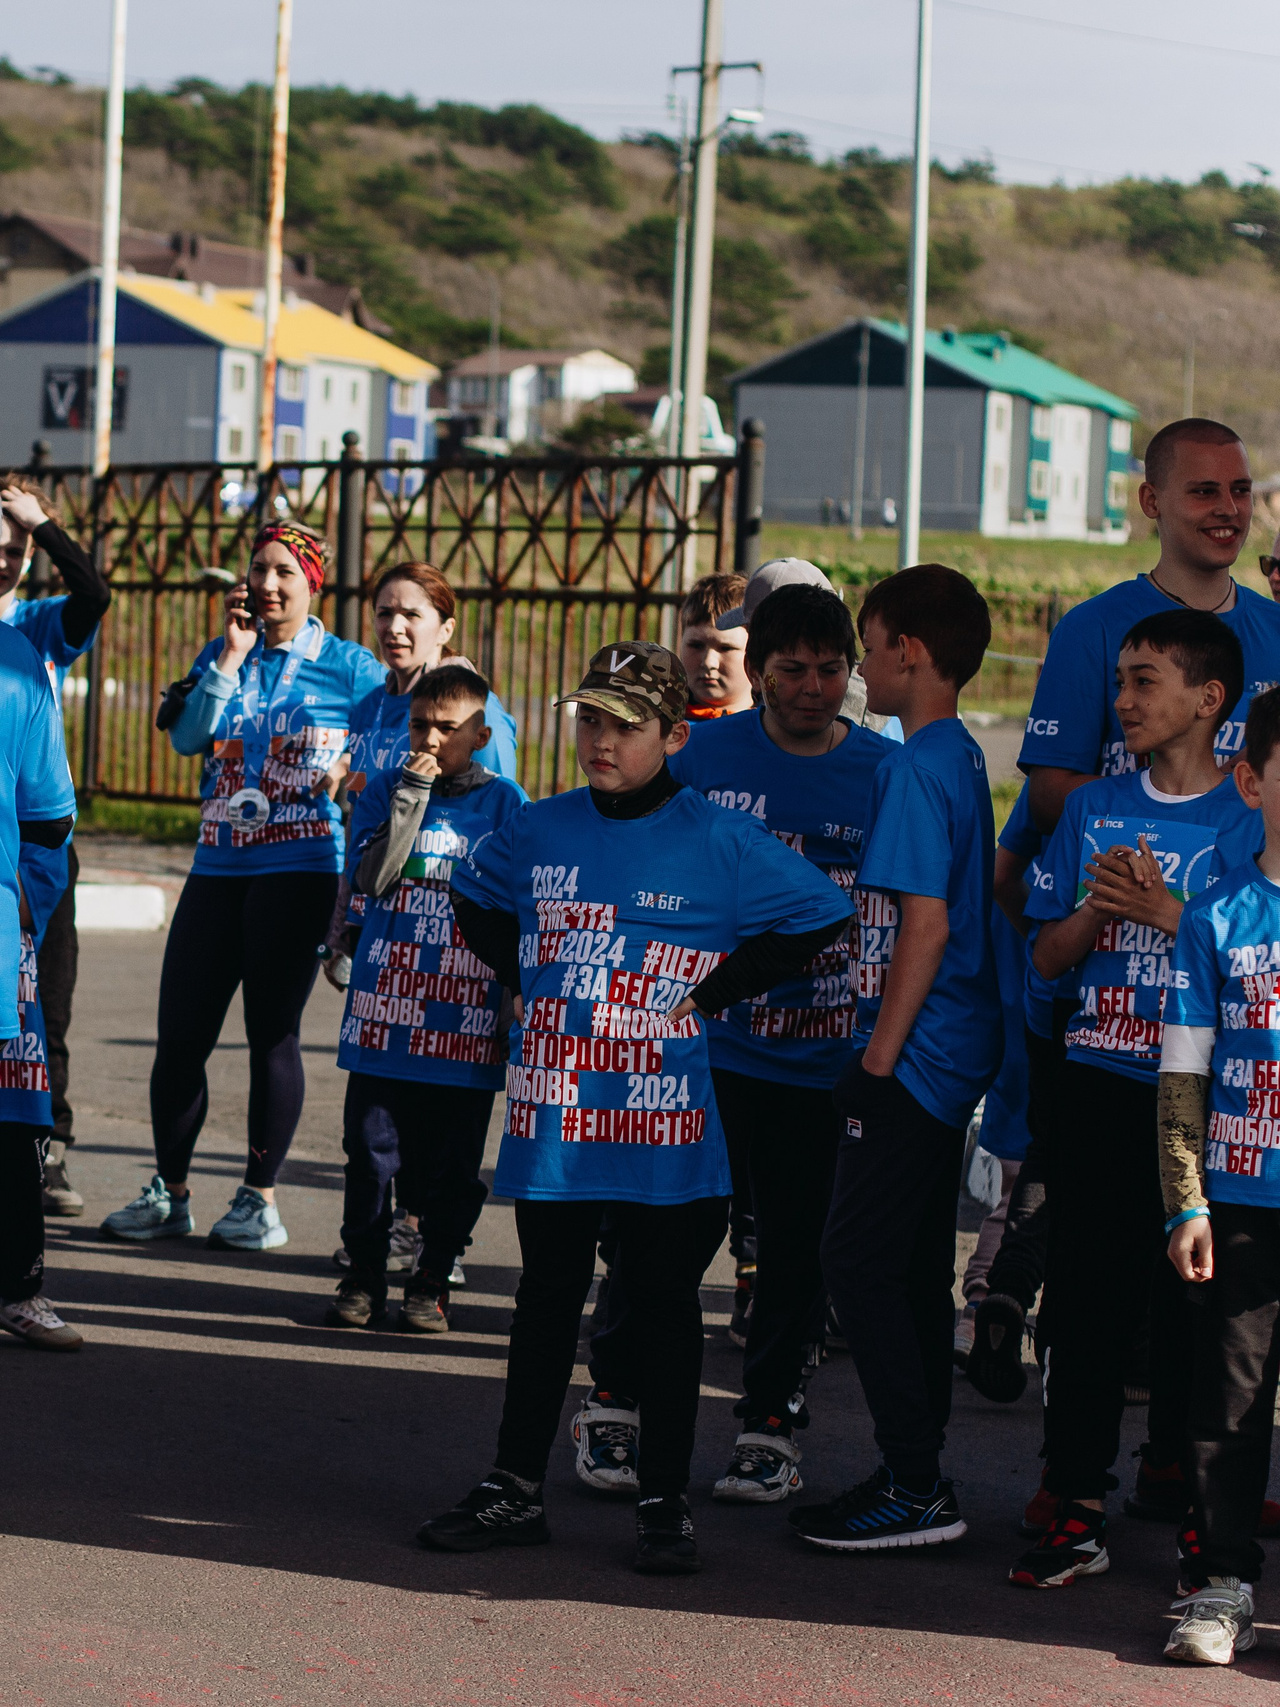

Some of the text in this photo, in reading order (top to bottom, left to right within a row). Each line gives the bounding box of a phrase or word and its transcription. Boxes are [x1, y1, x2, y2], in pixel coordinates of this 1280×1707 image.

[610, 650, 636, 673] V
[531, 865, 579, 899] 2024
[535, 900, 618, 932] #МЕЧТА
[375, 967, 490, 1007] #ГОРДОСТЬ
[813, 973, 853, 1007] 202
[751, 1006, 856, 1038] #ЕДИНСТ
[522, 1030, 663, 1074] #ГОРДОСТЬ
[1222, 1058, 1280, 1090] #ЗАБЕ
[626, 1074, 690, 1110] 2024
[561, 1107, 705, 1146] #ЕДИНСТВО
